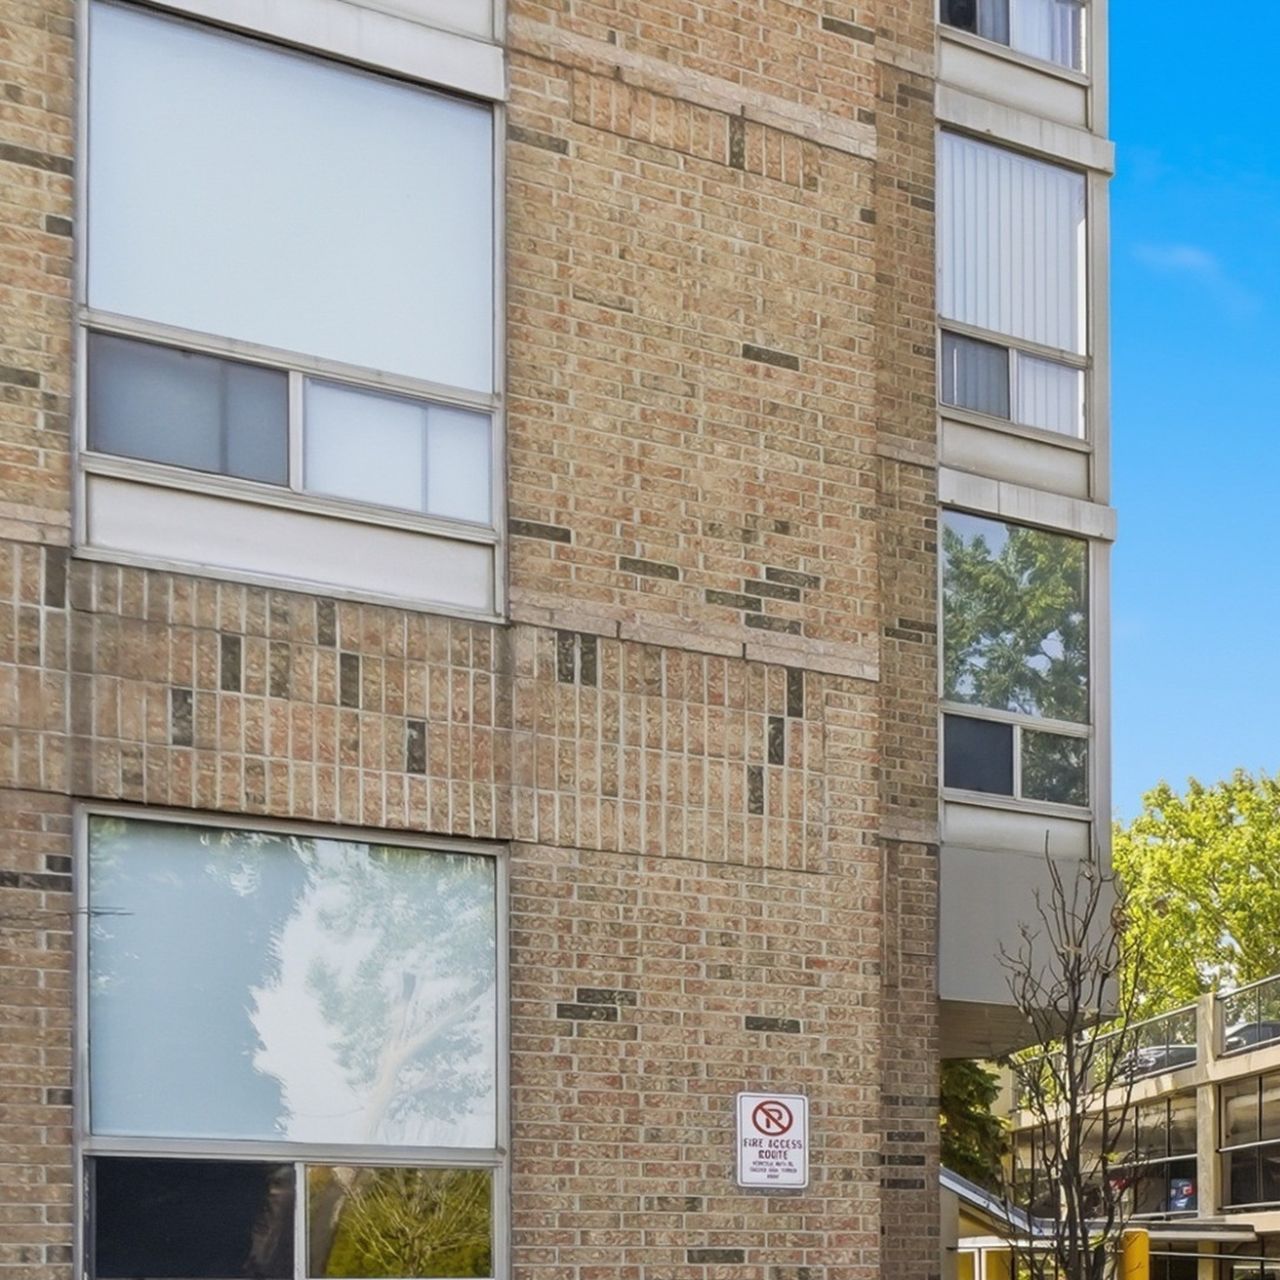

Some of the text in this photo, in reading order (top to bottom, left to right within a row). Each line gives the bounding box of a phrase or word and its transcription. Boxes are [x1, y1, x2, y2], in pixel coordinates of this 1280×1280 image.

[743, 1138, 803, 1149] FIRE ACCESS
[758, 1150, 788, 1160] ROUTE
